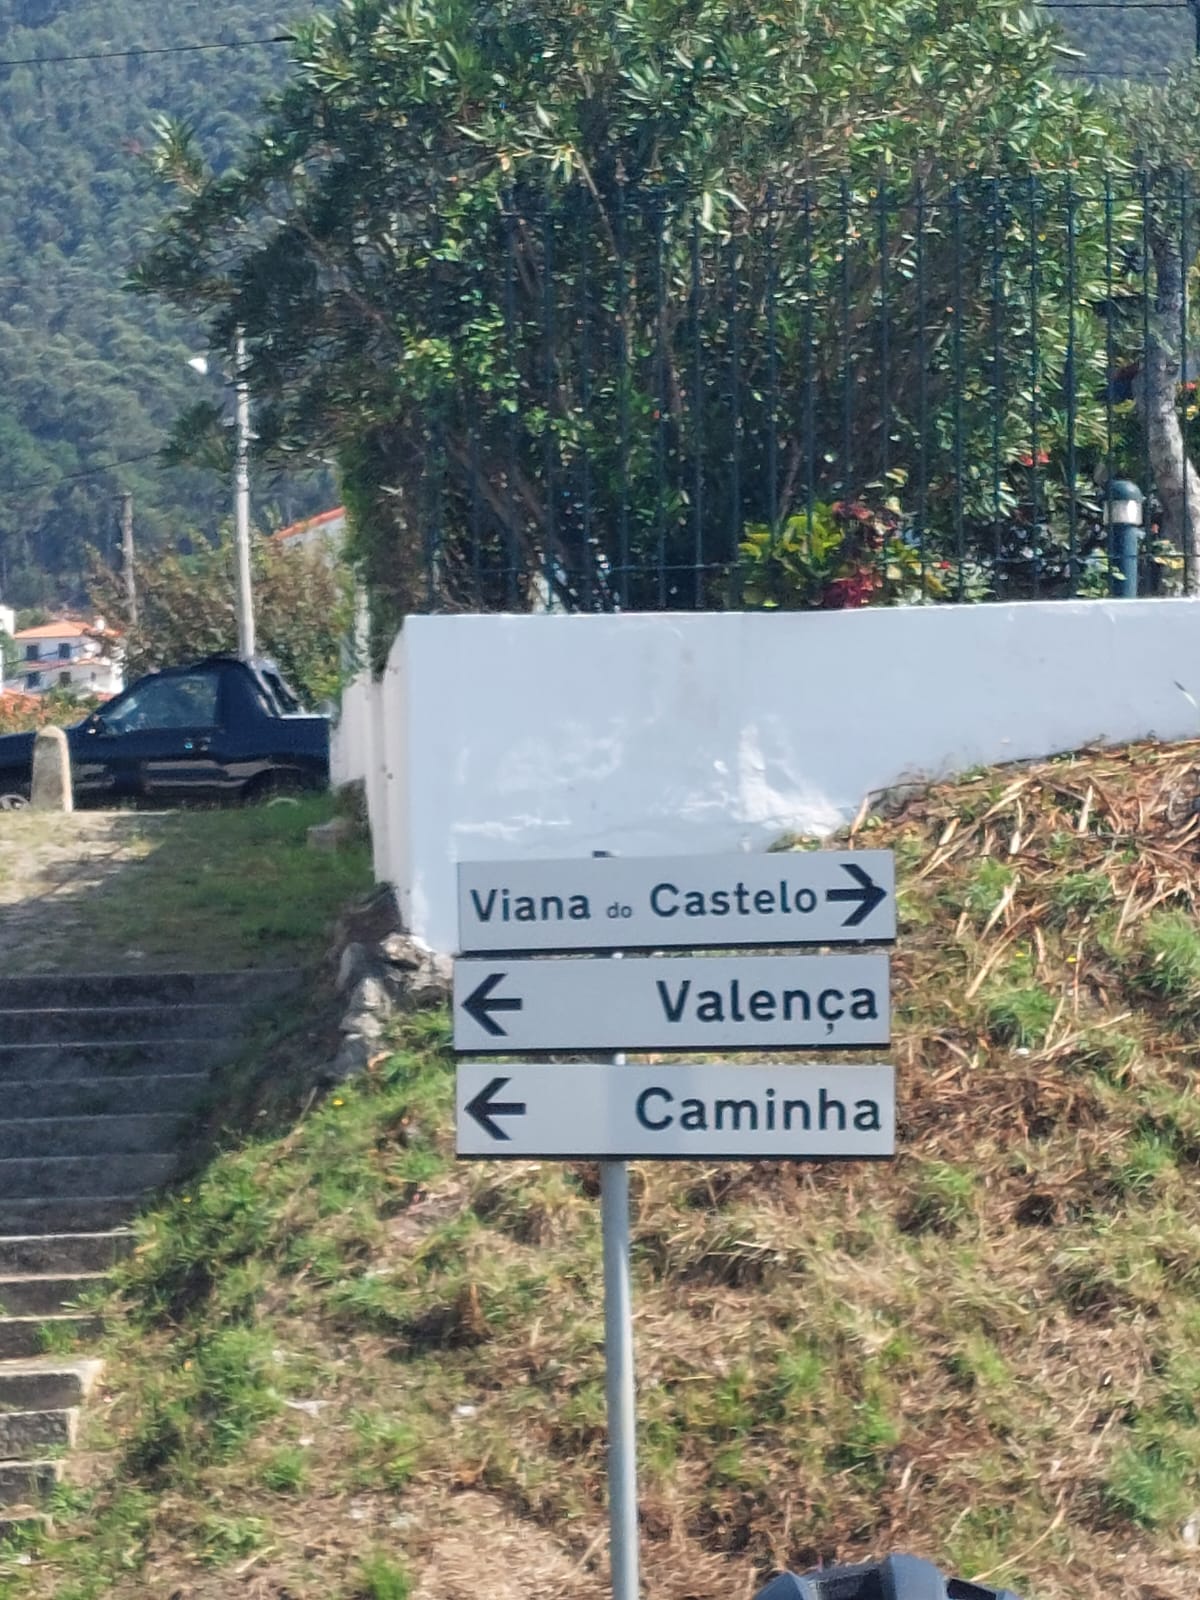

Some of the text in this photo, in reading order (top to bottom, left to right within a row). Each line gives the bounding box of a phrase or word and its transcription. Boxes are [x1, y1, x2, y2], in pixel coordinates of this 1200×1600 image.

[470, 881, 818, 922] Viana do Castelo
[656, 979, 879, 1035] Valença
[635, 1087, 881, 1131] Caminha
